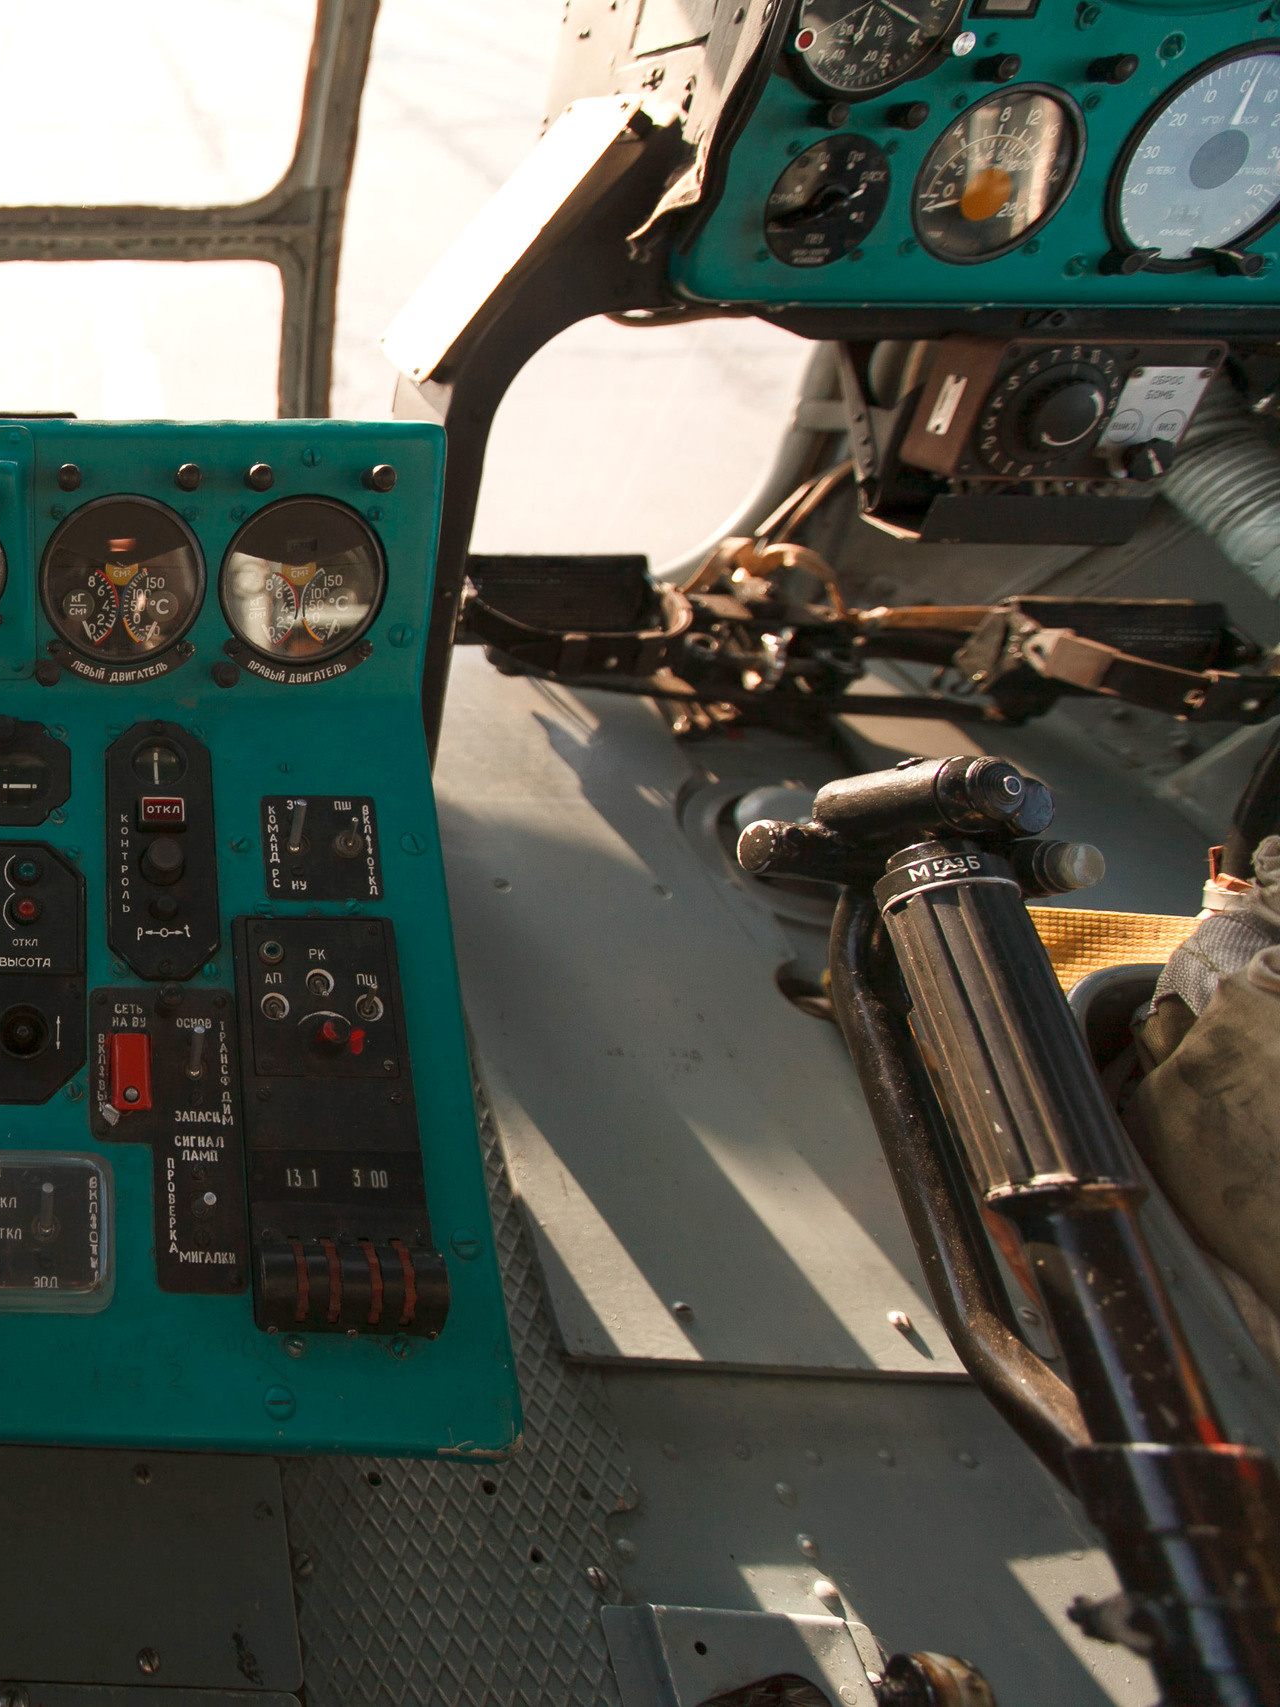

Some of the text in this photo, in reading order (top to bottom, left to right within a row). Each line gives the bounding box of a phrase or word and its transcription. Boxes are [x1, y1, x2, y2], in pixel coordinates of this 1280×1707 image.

[874, 24, 888, 38] 10
[906, 28, 920, 45] 4
[862, 50, 879, 62] 20
[879, 53, 892, 69] 5
[1240, 78, 1252, 94] 0
[1202, 88, 1218, 104] 10
[1262, 88, 1279, 104] 10
[1000, 106, 1013, 122] 8
[1025, 108, 1043, 126] 12
[1168, 112, 1188, 127] 20
[952, 122, 964, 138] 4
[1142, 146, 1160, 160] 30
[1146, 166, 1176, 176] ВЛЕВО
[942, 183, 956, 198] 0
[1130, 182, 1148, 196] 40
[1245, 182, 1263, 196] 40
[1051, 349, 1062, 362] 7
[1008, 376, 1020, 390] 5
[88, 576, 96, 588] 8
[146, 576, 165, 589] 150
[265, 580, 274, 591] 8
[324, 574, 343, 587] 150
[97, 585, 105, 596] 6
[132, 589, 152, 600] 100
[275, 588, 283, 599] 6
[310, 588, 330, 600] 100
[102, 600, 110, 611] 4
[280, 603, 289, 614] 4
[308, 600, 324, 612] 50
[97, 614, 105, 625] 2
[133, 613, 141, 624] 0
[276, 616, 284, 628] 2
[312, 612, 320, 623] 0
[89, 624, 96, 634] 0
[70, 660, 168, 684] ЛЕВЫЙ ДВИГАТЕЛЬ
[247, 660, 348, 684] ПРАВЫЙ ДВИГАТЕЛЬ
[146, 804, 180, 814] ОТКЛ
[334, 800, 352, 810] ПШ
[268, 806, 280, 864] КОМАНД
[362, 805, 378, 895] ВКЛ ОТКЛ
[120, 814, 130, 913] КОНТРОЛЬ
[907, 856, 981, 882] М ГАЗ Б
[292, 880, 308, 890] НУ
[12, 938, 38, 948] ОТКЛ
[308, 948, 326, 960] РК
[264, 972, 282, 984] АП
[114, 1003, 143, 1014] СЕТЬ
[112, 1016, 146, 1028] НА ВУ
[176, 1018, 212, 1029] ОСНОВ
[98, 1033, 106, 1064] ВКЛ
[220, 1021, 234, 1126] ТРАНСФ ДИМ
[174, 1135, 225, 1148] СИГНАЛ
[182, 1150, 219, 1162] ЛАМП
[166, 1158, 179, 1254] ПРОВЕРКА
[179, 1251, 236, 1265] МИГАЛКИ
